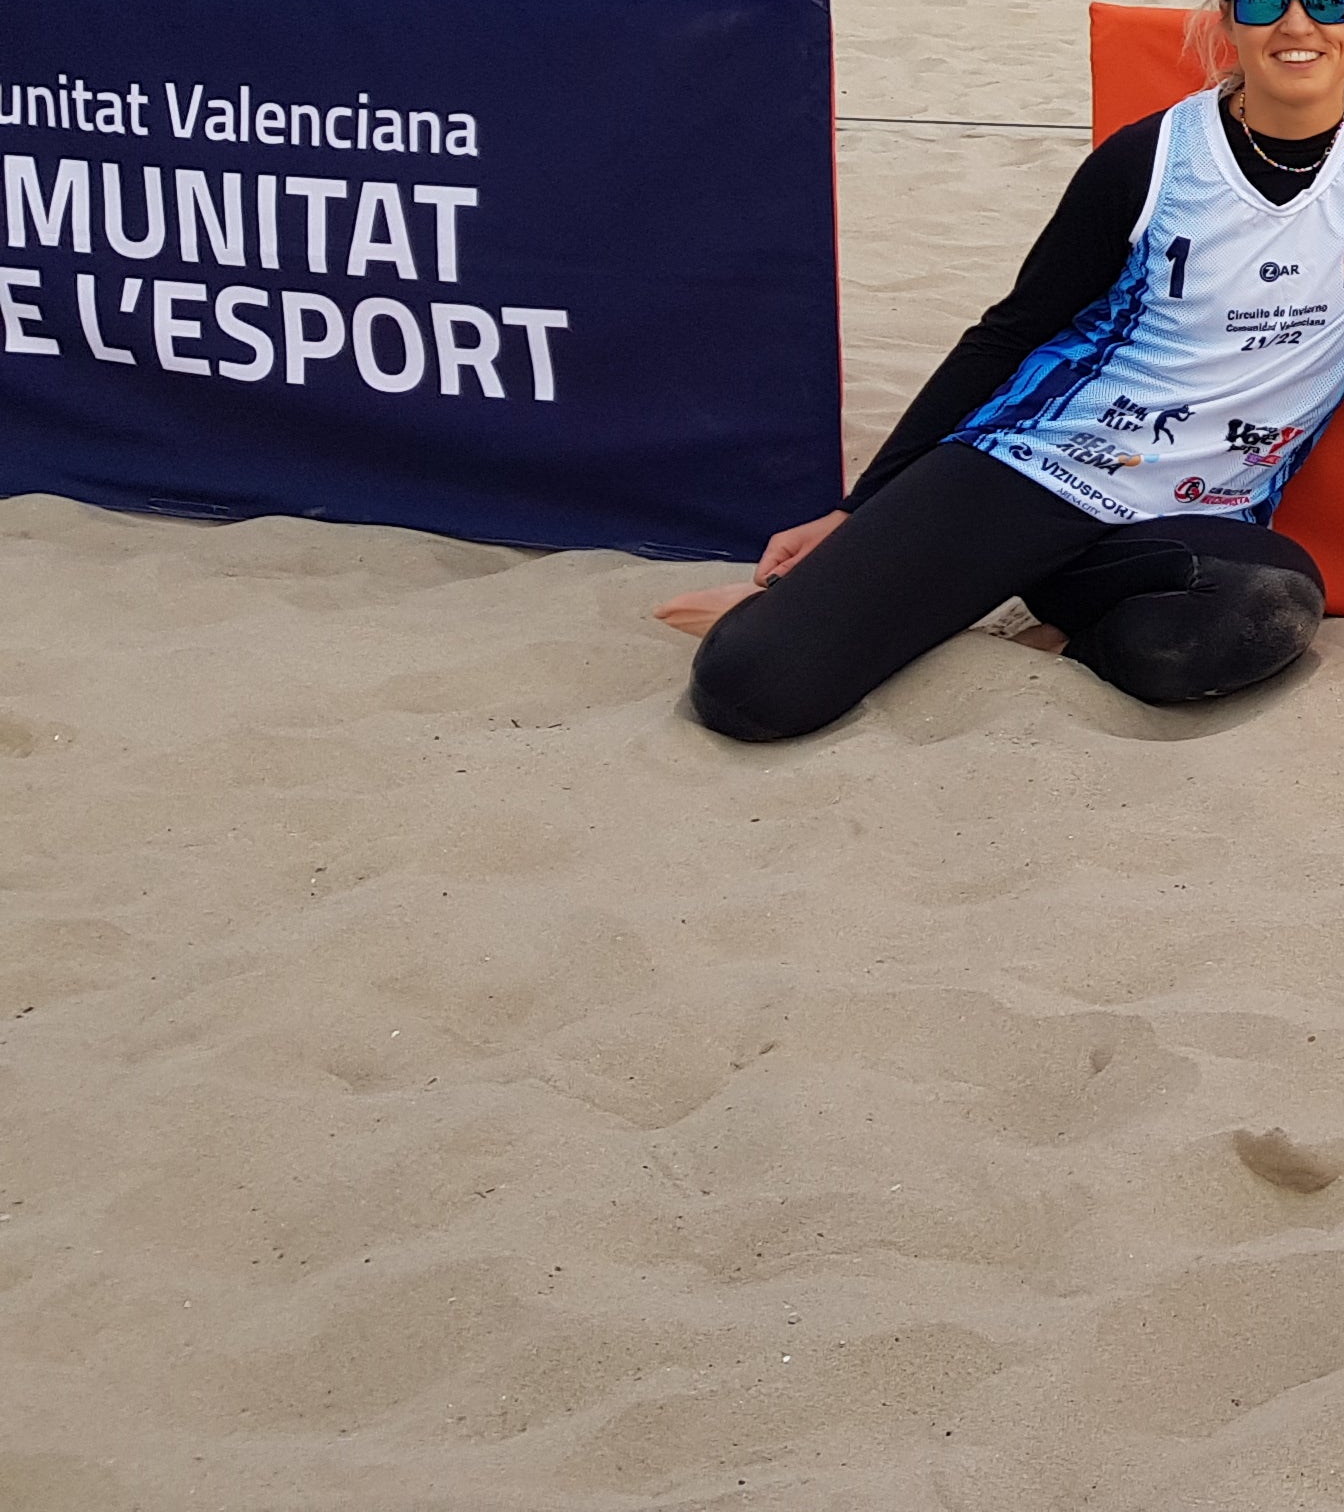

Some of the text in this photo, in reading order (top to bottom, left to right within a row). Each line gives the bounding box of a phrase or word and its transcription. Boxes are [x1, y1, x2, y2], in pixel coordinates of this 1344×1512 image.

[165, 81, 479, 157] Valenciana
[3, 154, 479, 283] MUNITAT
[1164, 234, 1192, 300] 1
[75, 272, 569, 402] L'ESPORT
[1227, 307, 1271, 321] Circuito
[1273, 305, 1286, 318] de
[1240, 330, 1302, 352] 21/22
[1041, 457, 1139, 520] VIZIUSPORT
